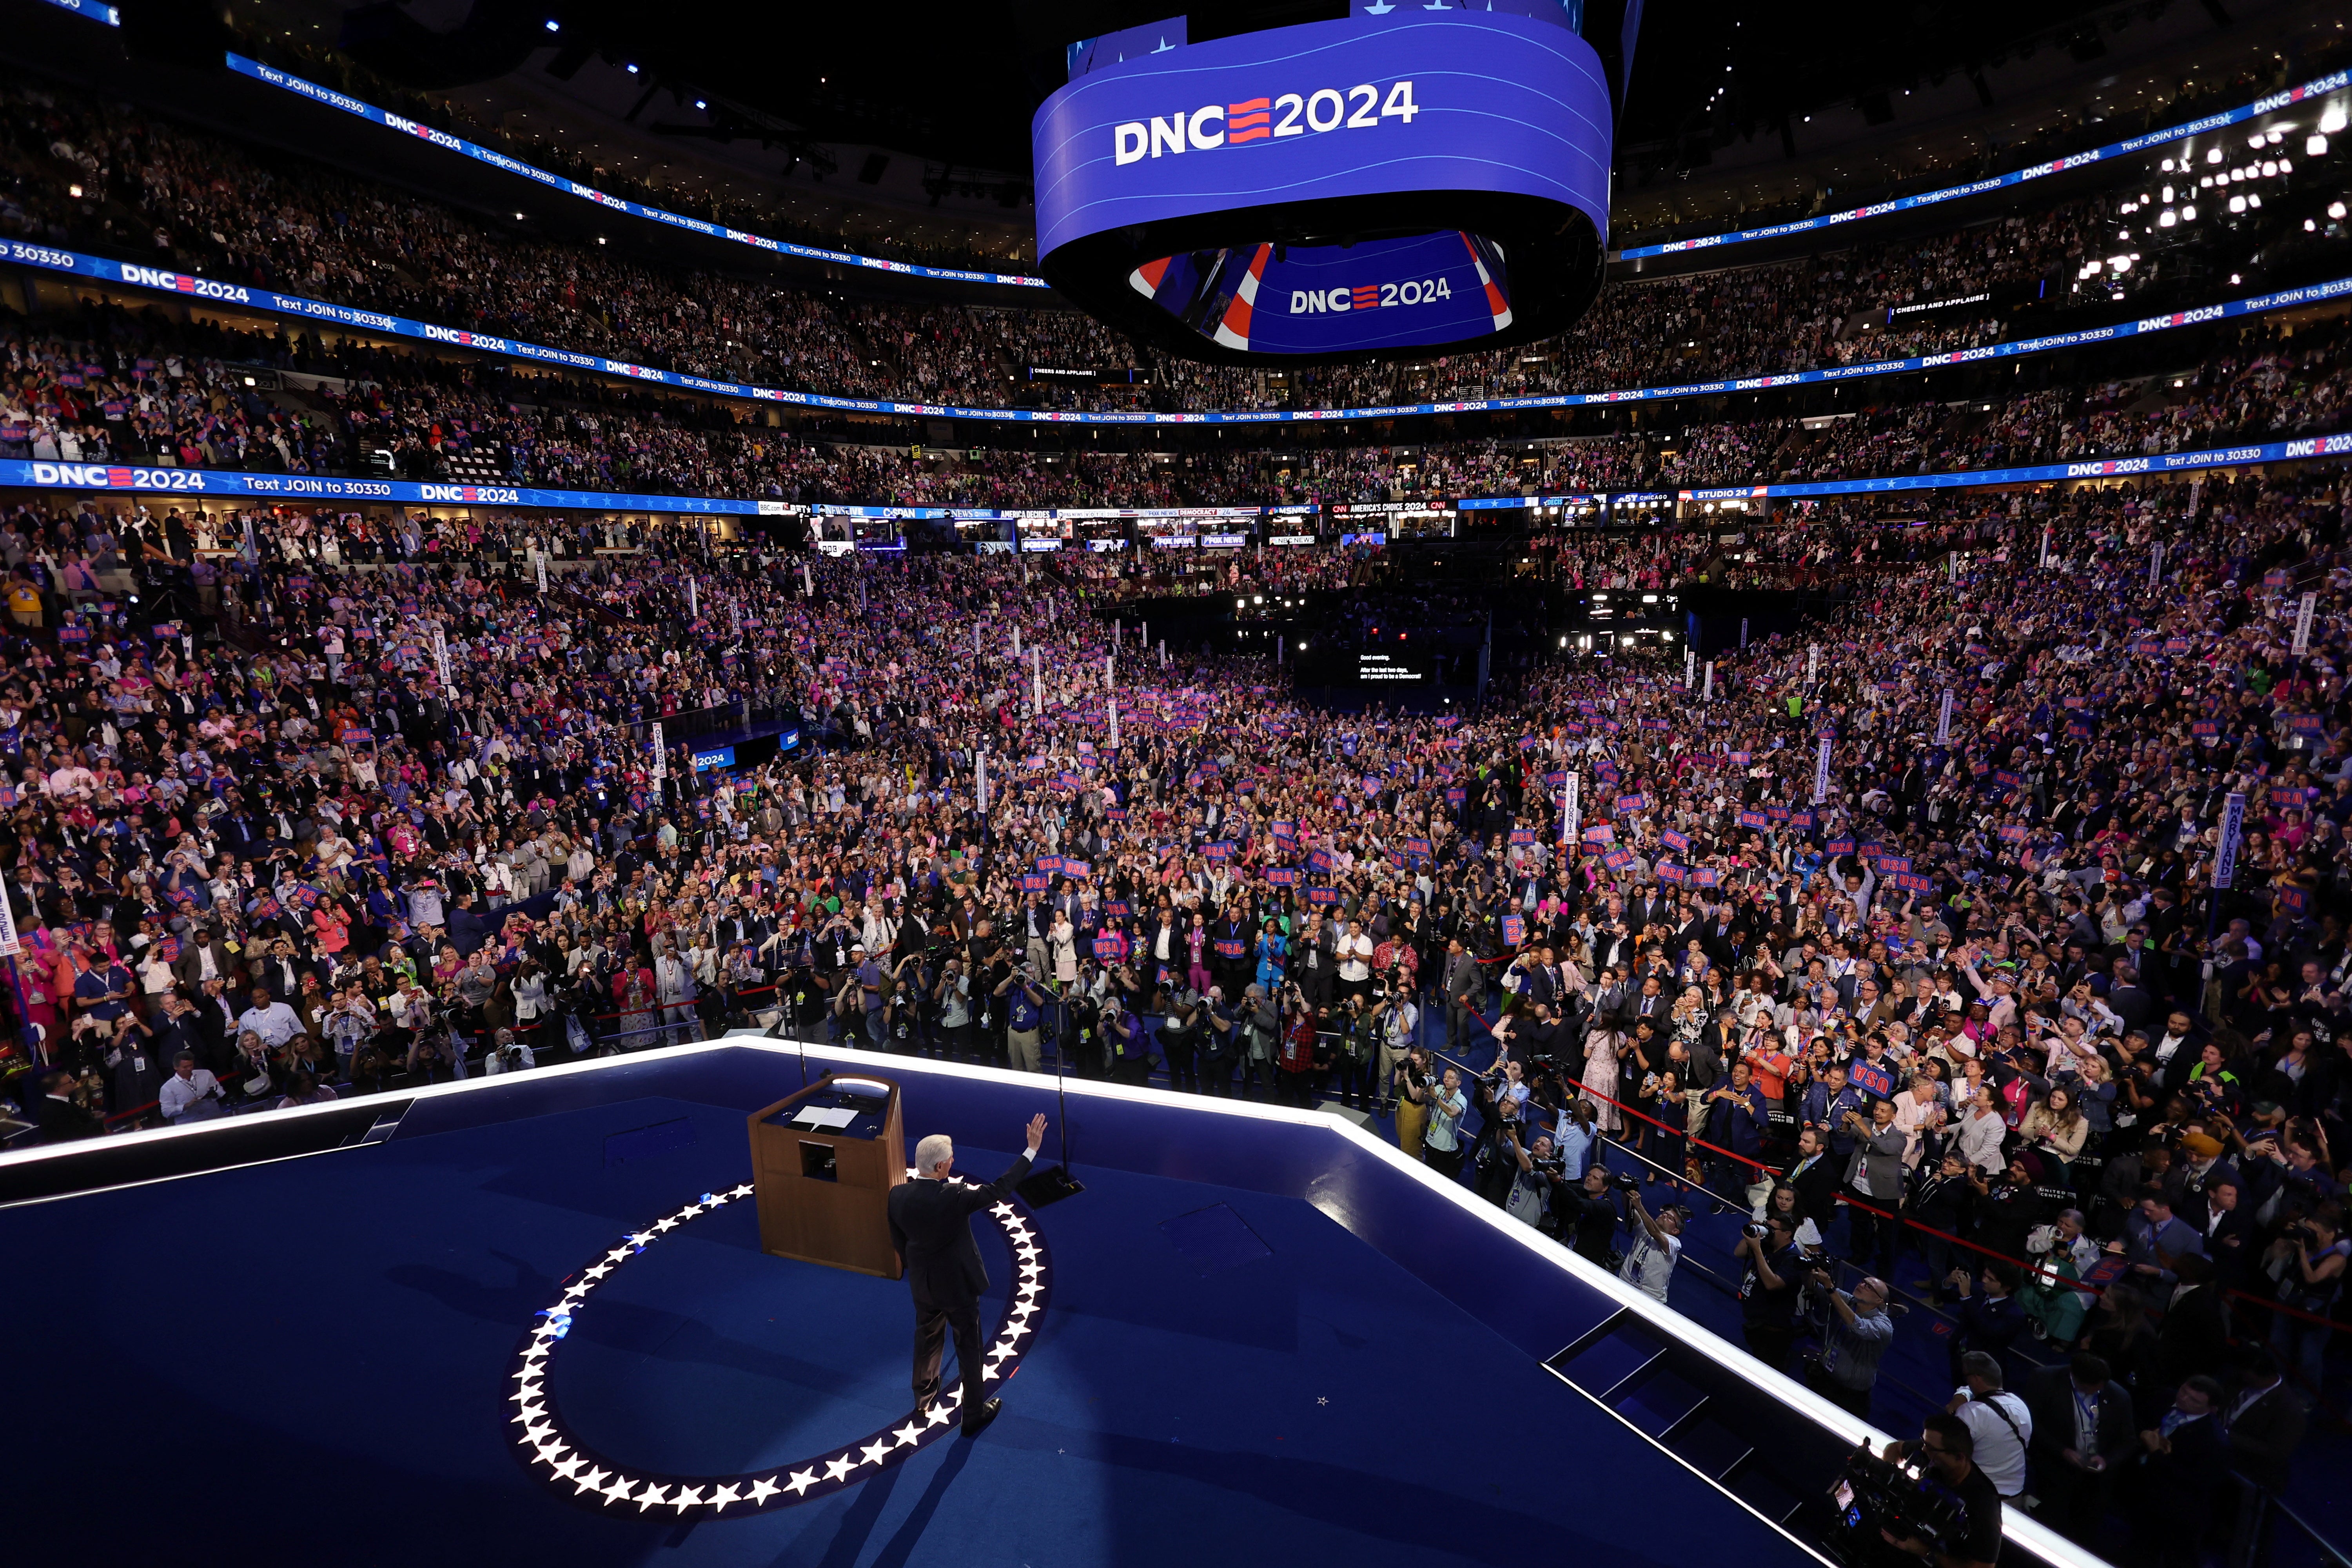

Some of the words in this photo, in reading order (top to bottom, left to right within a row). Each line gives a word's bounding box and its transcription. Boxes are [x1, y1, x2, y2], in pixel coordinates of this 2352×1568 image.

[258, 66, 283, 83] Text
[286, 78, 314, 94] JOIN
[316, 89, 328, 100] to
[330, 93, 364, 113] 30330
[2254, 93, 2291, 114] DNC
[2303, 73, 2347, 97] 2024
[385, 113, 418, 134] DNC
[428, 129, 461, 150] 2024
[1115, 105, 1224, 166] DNC
[1274, 81, 1419, 137] 2024
[2122, 140, 2143, 151] Text
[2145, 131, 2171, 144] JOIN
[2188, 116, 2226, 132] 30330
[2022, 163, 2053, 180] DNC
[2063, 150, 2099, 168] 2024
[13, 245, 73, 267] 30330
[121, 265, 176, 289] DNC
[195, 279, 249, 303] 2024
[1290, 288, 1350, 313] DNC
[1381, 278, 1451, 307] 2024
[1896, 304, 1926, 314] CHEERS
[1945, 294, 1985, 306] APPLAUSE
[273, 296, 301, 310] Text
[305, 303, 336, 317] JOIN
[338, 310, 351, 320] to
[353, 312, 393, 330] 30330
[2138, 316, 2172, 332] DNC
[2183, 306, 2223, 323] 2024
[425, 325, 460, 343] DNC
[471, 334, 506, 351] 2024
[1434, 403, 1455, 412] DNC
[1463, 402, 1488, 412] 2024
[2165, 456, 2185, 466] Text
[2186, 454, 2212, 464] JOIN
[2214, 453, 2224, 461] to
[2226, 448, 2261, 461] 30330
[2067, 463, 2103, 476] DNC
[2114, 459, 2149, 472] 2024
[33, 464, 108, 486] DNC
[133, 470, 205, 490] 2024
[243, 477, 279, 490] Text
[284, 479, 322, 492] JOIN
[326, 482, 341, 493] to
[344, 483, 390, 495] 30330
[421, 485, 463, 501] DNC
[475, 488, 519, 503] 2024
[1697, 490, 1734, 501] STUDIO
[826, 506, 845, 515] NEWS
[951, 509, 973, 518] NEWS
[999, 510, 1027, 520] AMERICA
[1025, 510, 1051, 520] DECIDES
[1279, 506, 1310, 514] MSNBC
[1350, 504, 1383, 514] AMERICA'S
[1382, 503, 1405, 513] CHOICE
[1405, 502, 1428, 512] 2024
[987, 542, 1013, 552] NEWS
[1158, 537, 1173, 545] FOX
[1174, 536, 1194, 544] NEWS
[1208, 536, 1223, 544] FOX
[1223, 535, 1243, 544] NEWS
[536, 556, 546, 587] WYOMING
[60, 629, 86, 639] USA
[437, 637, 449, 677] VIRGINIA
[787, 734, 797, 745] DNC
[655, 729, 664, 771] OKLAHOMA
[698, 754, 724, 766] 2024
[1818, 746, 1828, 794] ILLINOIS
[1620, 797, 1642, 808] USA
[2272, 791, 2302, 804] USA
[1742, 813, 1765, 826] USA
[1510, 832, 1533, 842] USA
[1664, 832, 1688, 849] USA
[2220, 805, 2241, 876] MARYLAND
[1205, 845, 1225, 857] USA
[1407, 840, 1428, 853] USA
[1828, 842, 1853, 853] USA
[1038, 857, 1062, 870] USA
[1606, 850, 1630, 867] USA
[1880, 858, 1908, 872] USA
[1065, 862, 1087, 877] USA
[1899, 874, 1928, 891] USA
[1310, 891, 1336, 902] USA
[1506, 918, 1521, 943] USA
[1216, 942, 1242, 955] USA
[1854, 1065, 1889, 1094] USA
